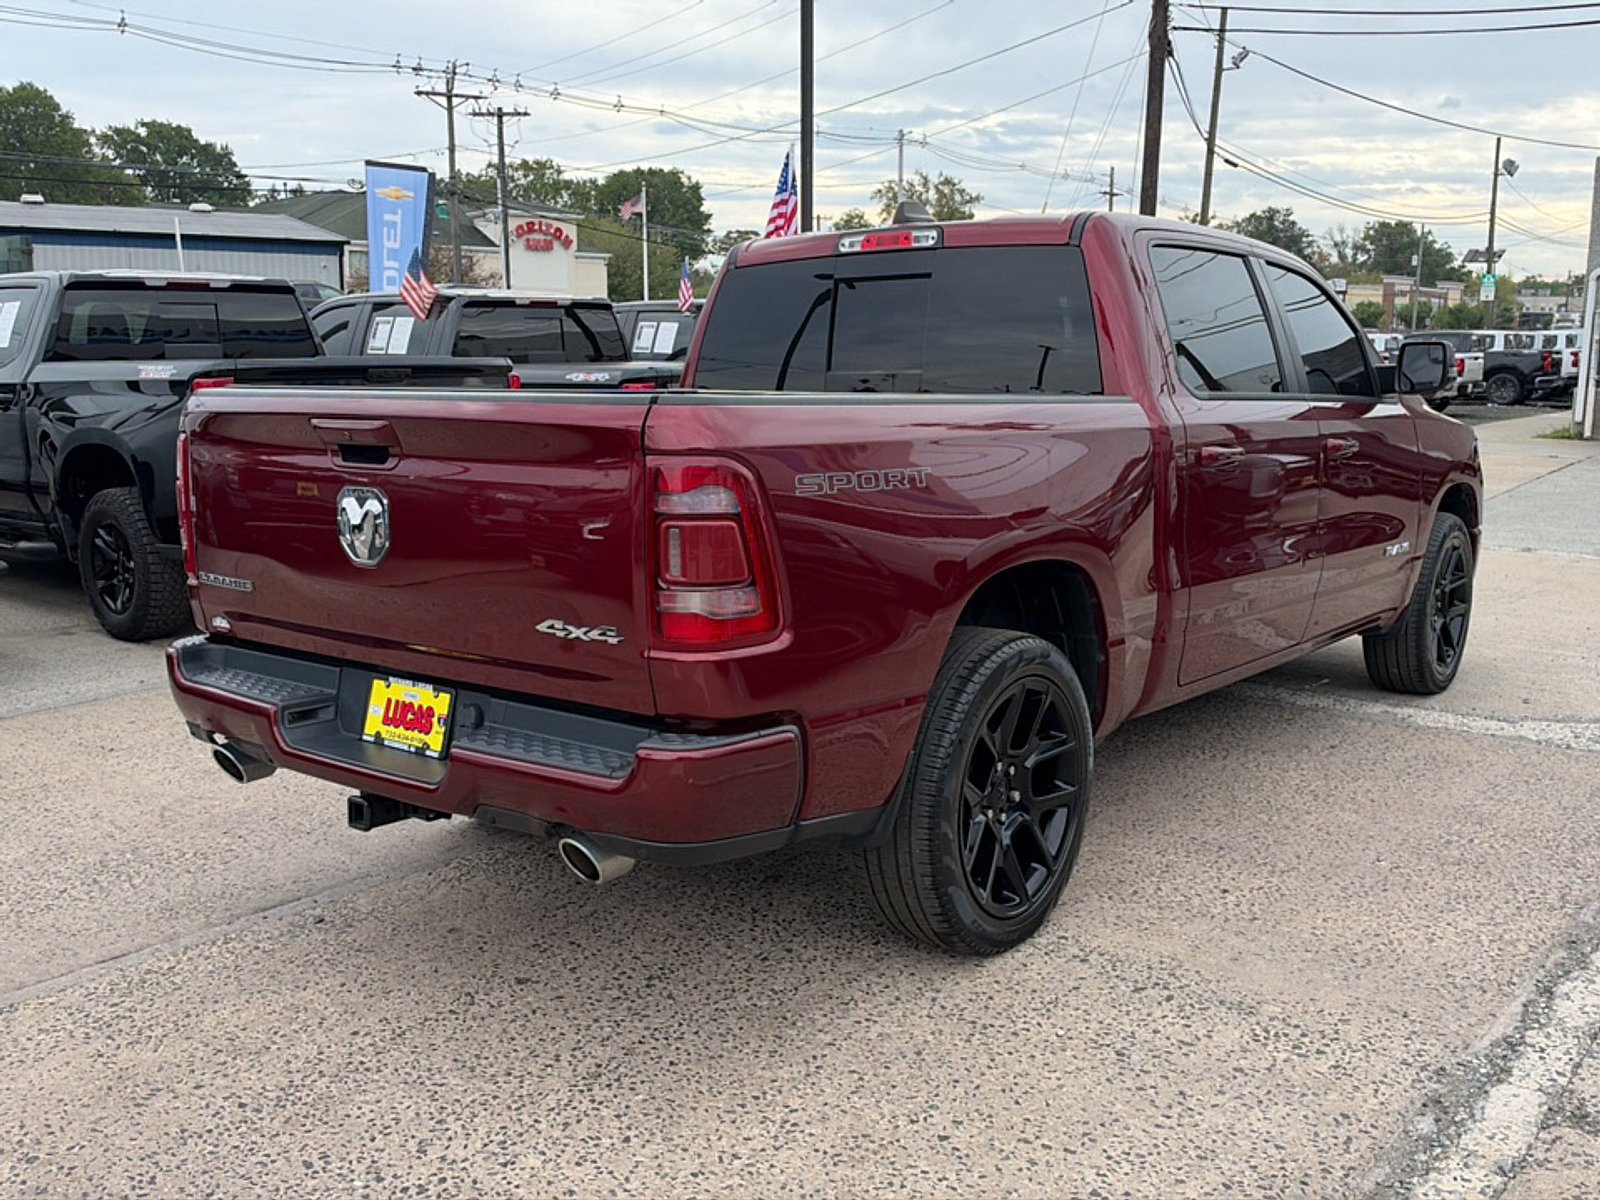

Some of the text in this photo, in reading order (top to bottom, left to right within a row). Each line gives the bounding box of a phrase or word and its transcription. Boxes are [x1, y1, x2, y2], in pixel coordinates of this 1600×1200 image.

[511, 220, 574, 250] ORIZON
[795, 466, 931, 496] SPORT
[382, 697, 434, 735] LUCAS
